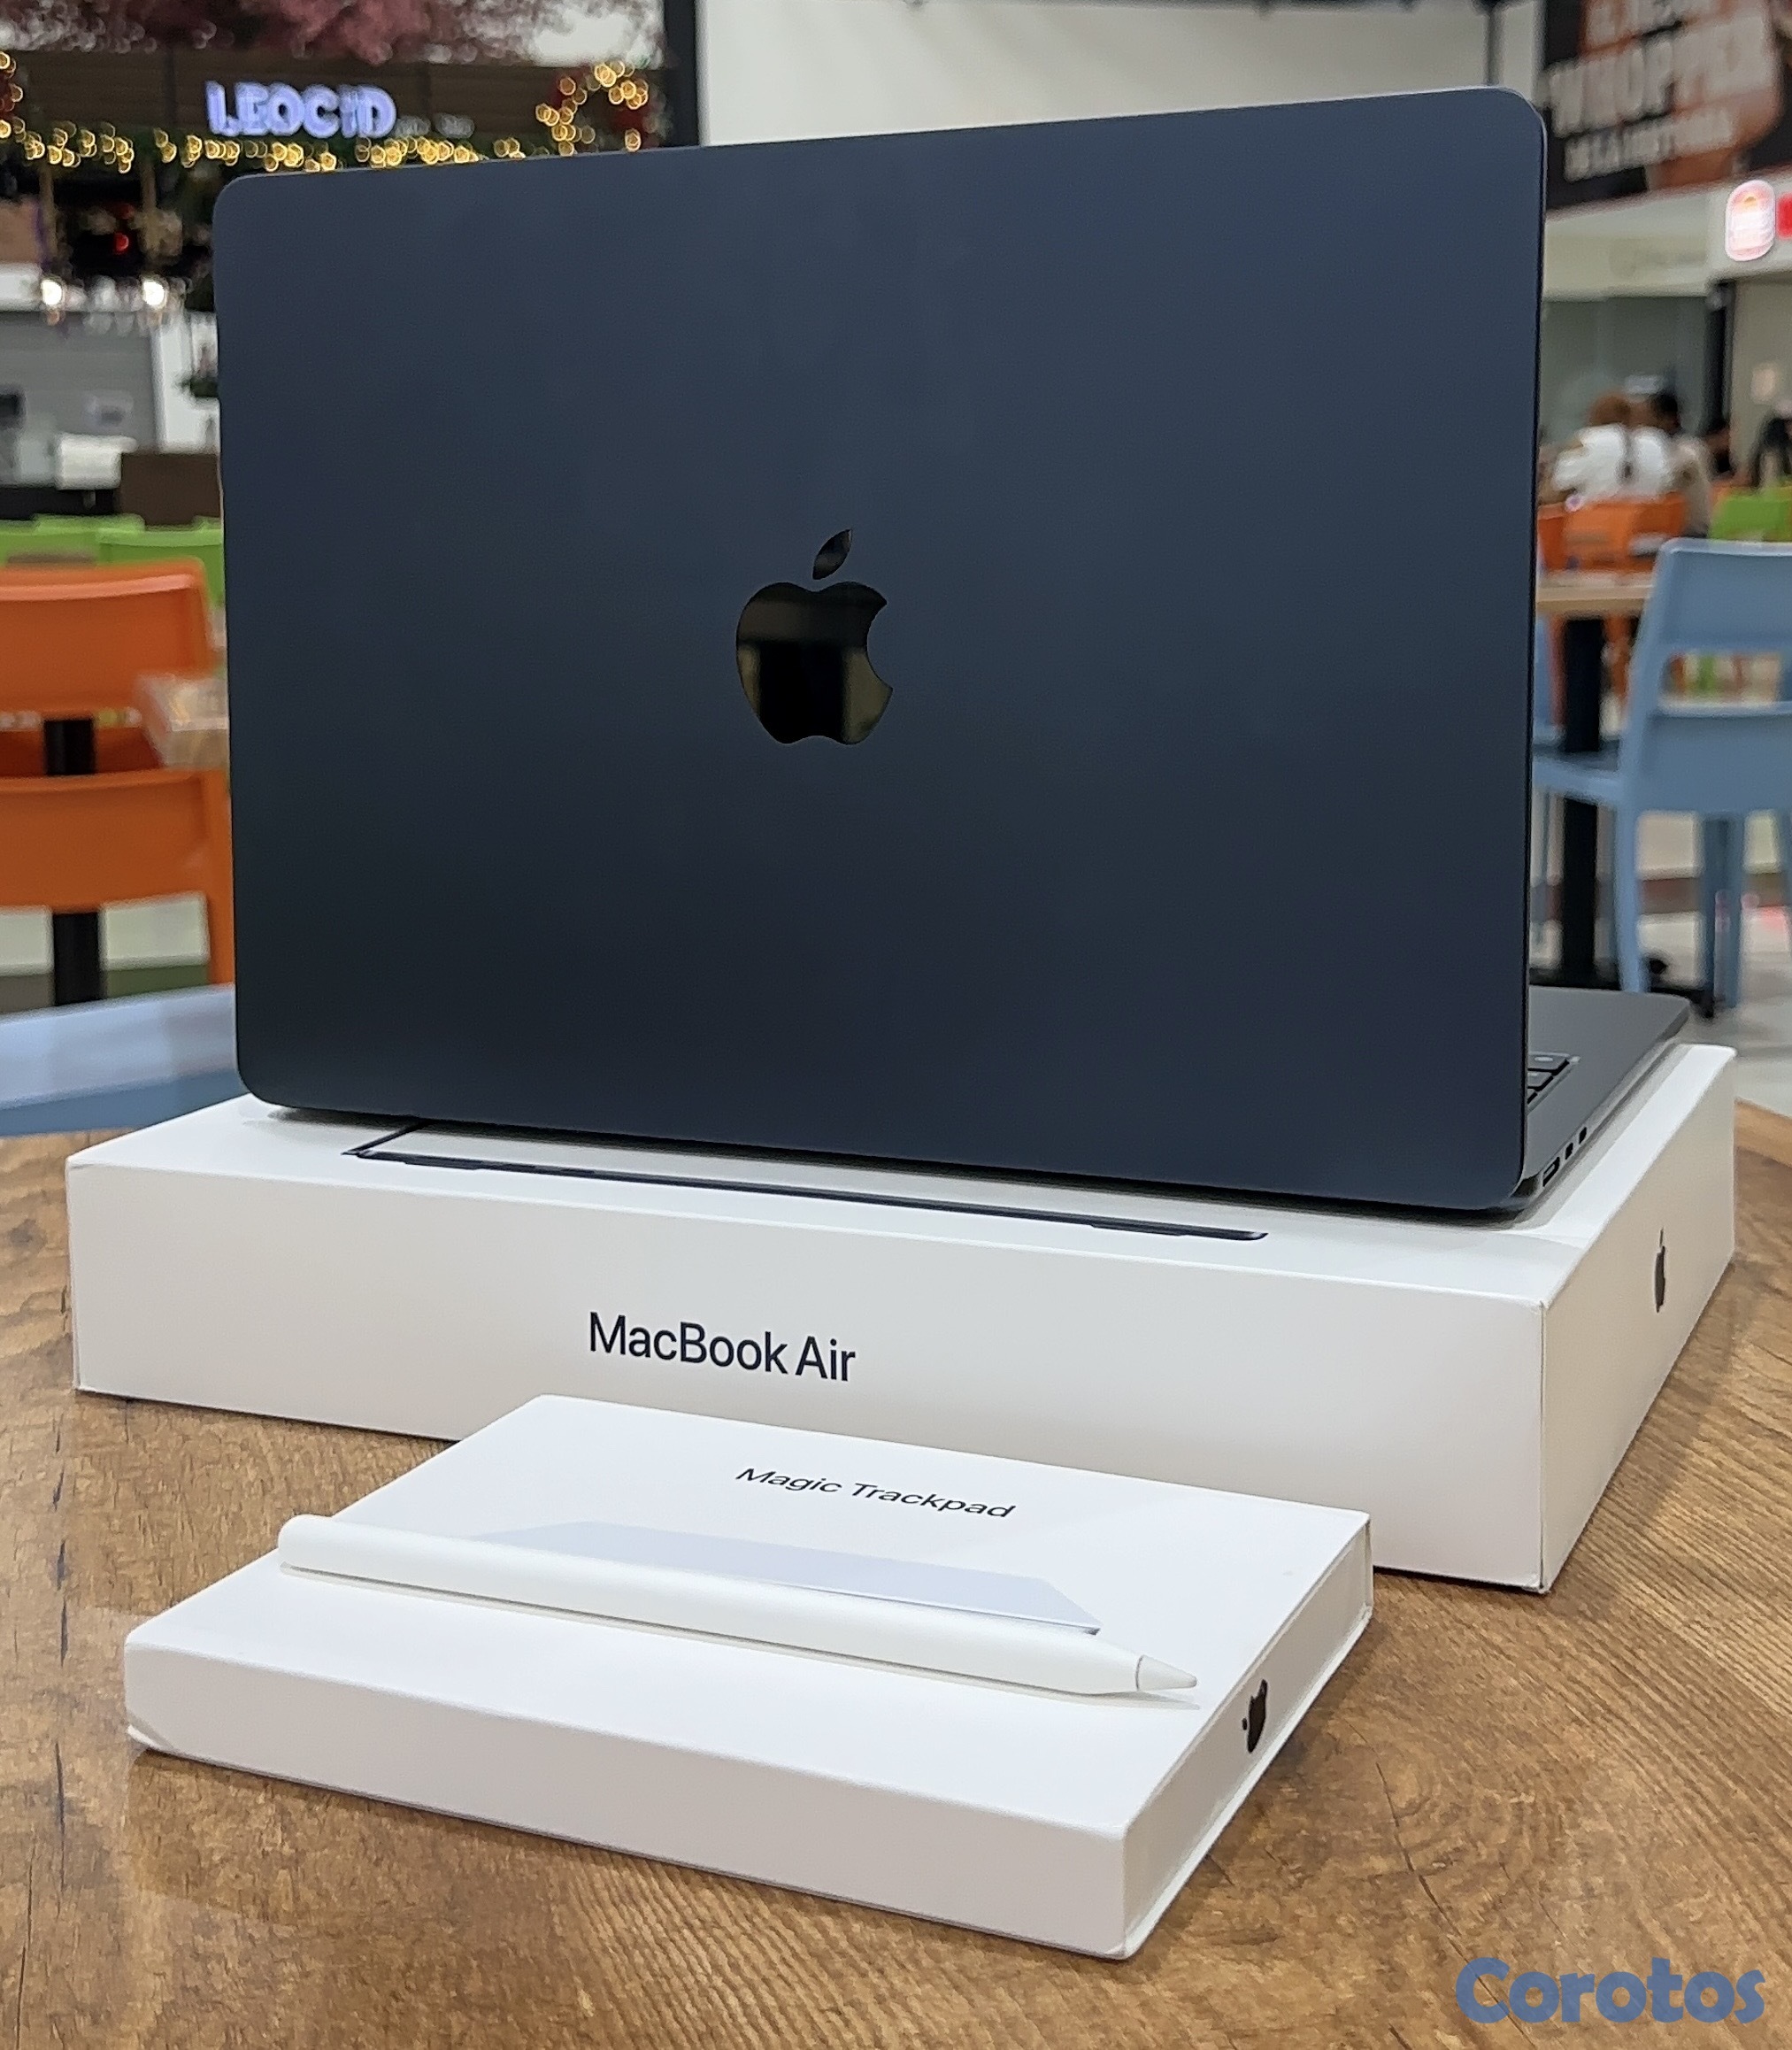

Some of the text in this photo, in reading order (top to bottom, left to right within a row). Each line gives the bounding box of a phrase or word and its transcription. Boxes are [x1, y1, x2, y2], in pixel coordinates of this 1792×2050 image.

[589, 1311, 856, 1382] MacBook Air
[735, 1468, 1017, 1518] Magic Trackpad
